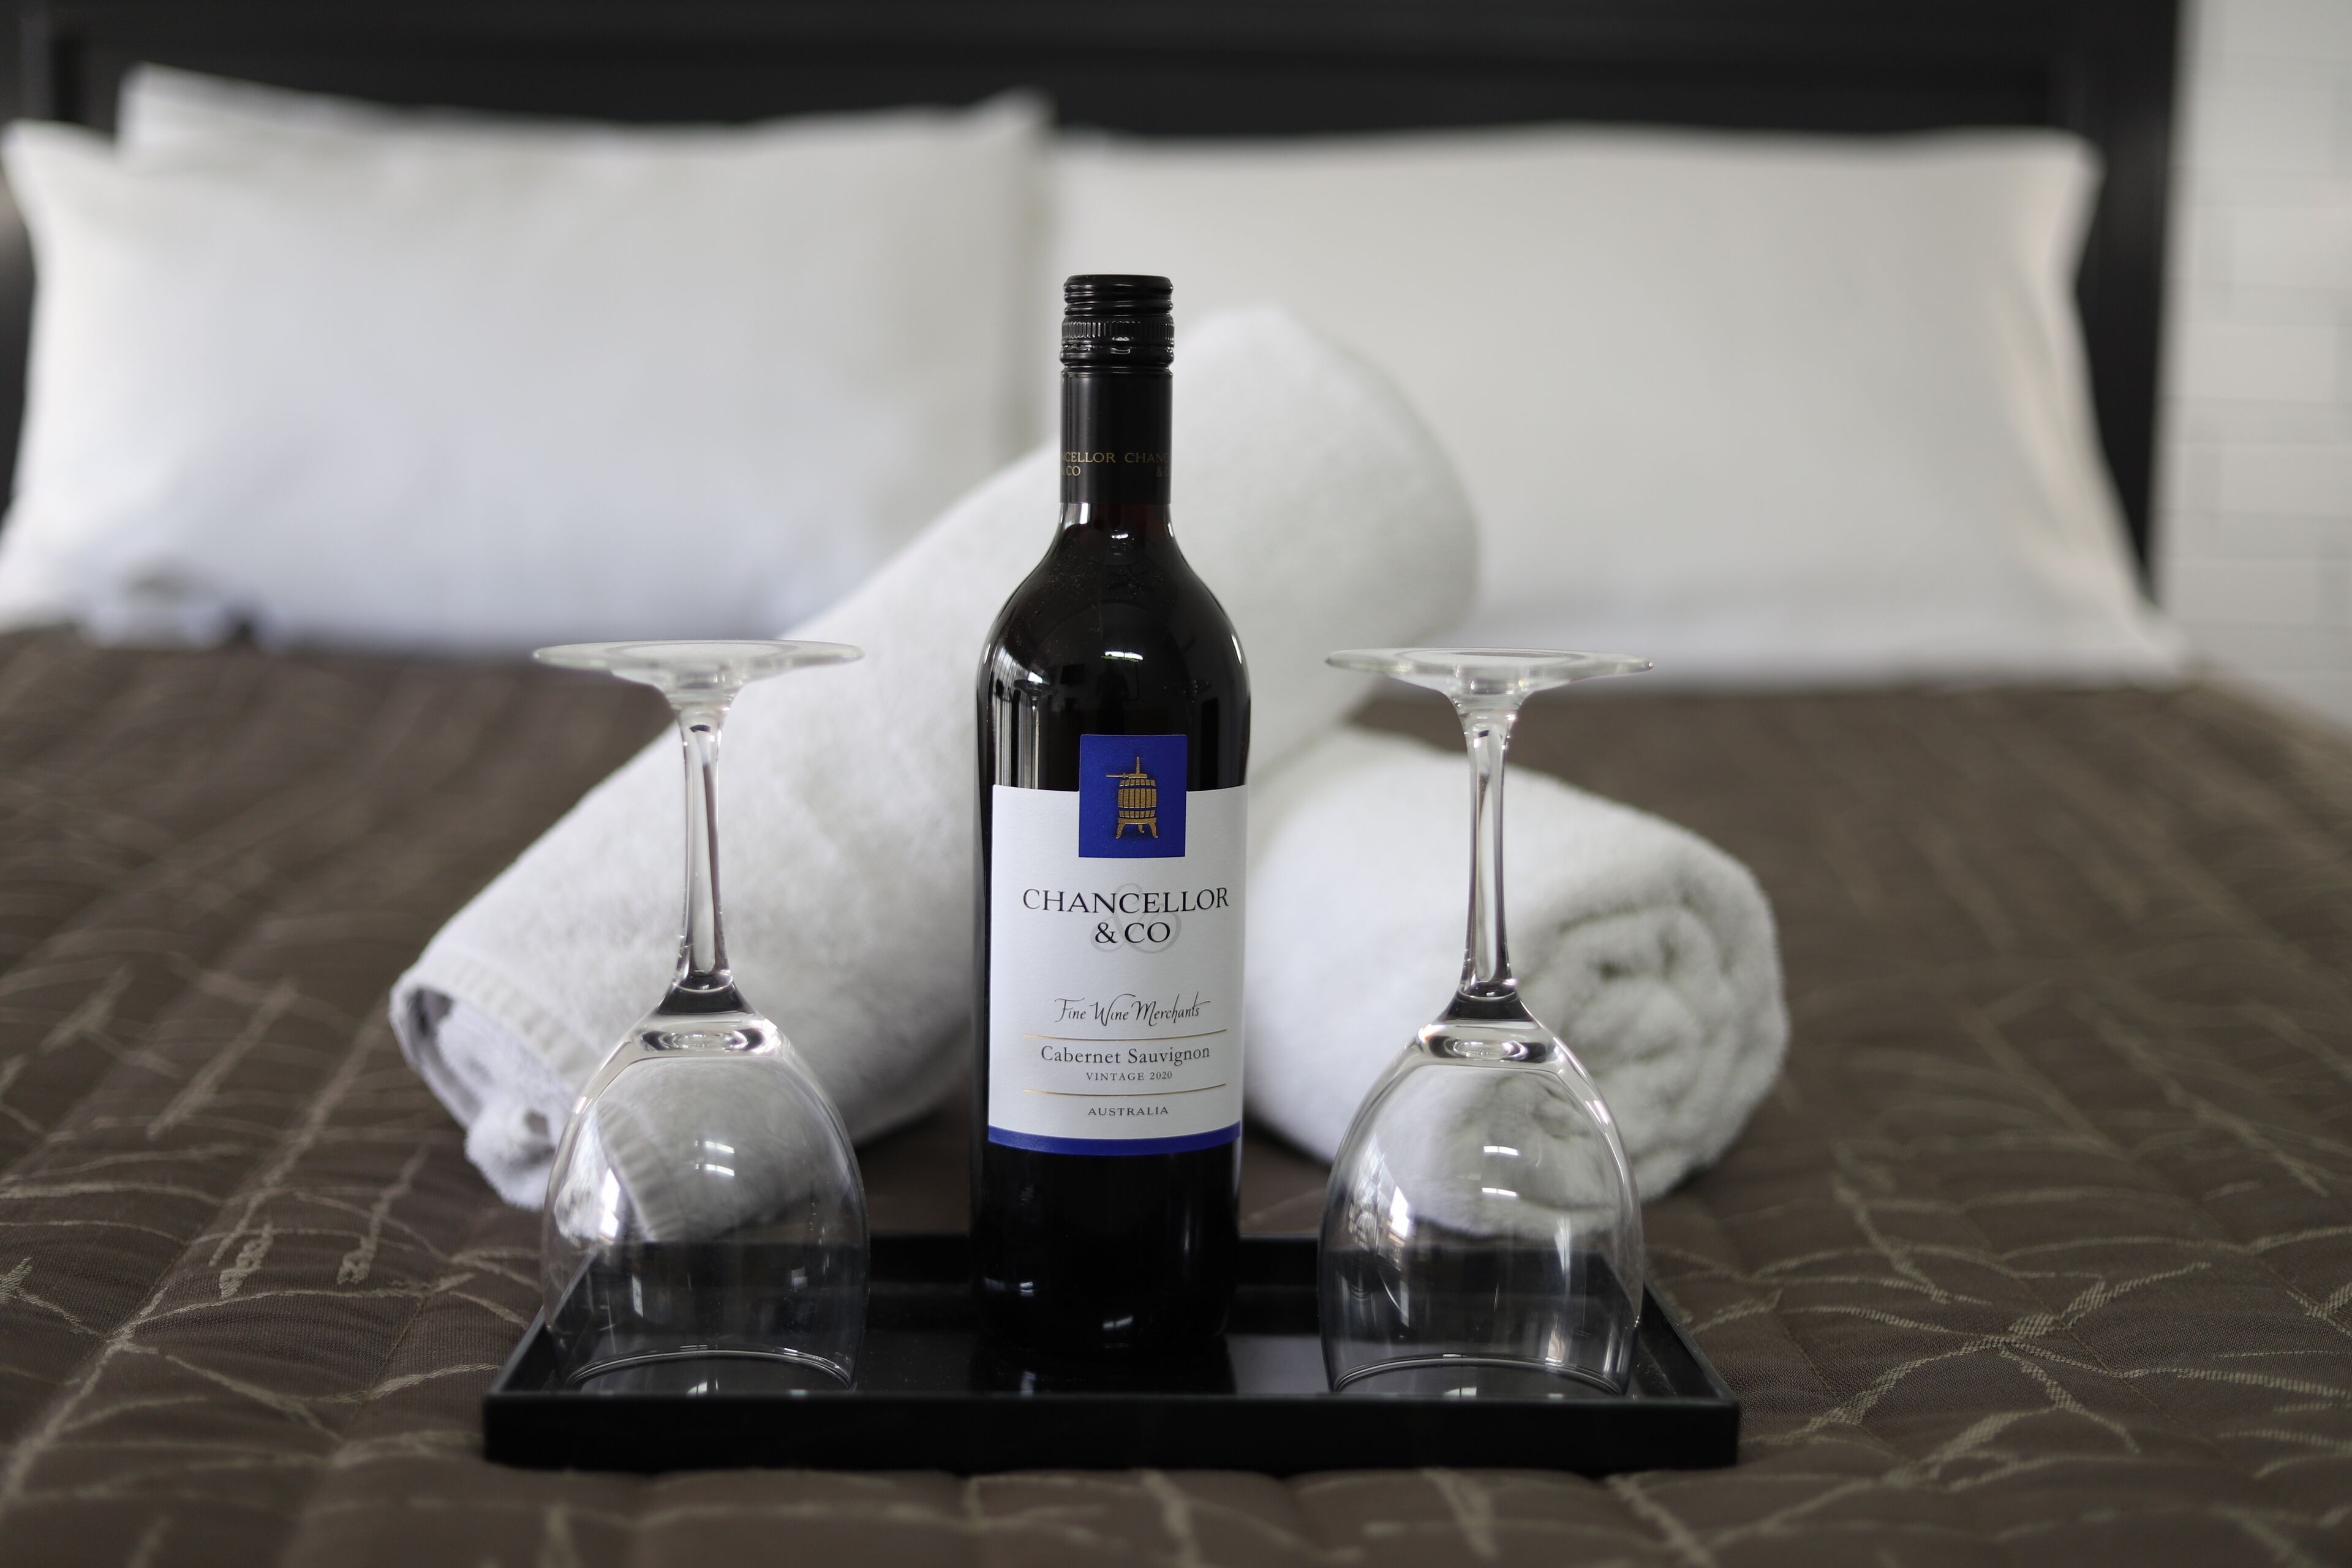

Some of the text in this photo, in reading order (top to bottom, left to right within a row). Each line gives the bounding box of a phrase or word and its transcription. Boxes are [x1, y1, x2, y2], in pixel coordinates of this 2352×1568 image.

[1023, 888, 1228, 913] CHANCELLOR
[1055, 992, 1210, 1026] Fine Wine Merchants
[1041, 1046, 1210, 1066] Cabernet Sauvignon
[1150, 1071, 1172, 1080] 2020
[1088, 1107, 1168, 1115] AUSTRALIA
